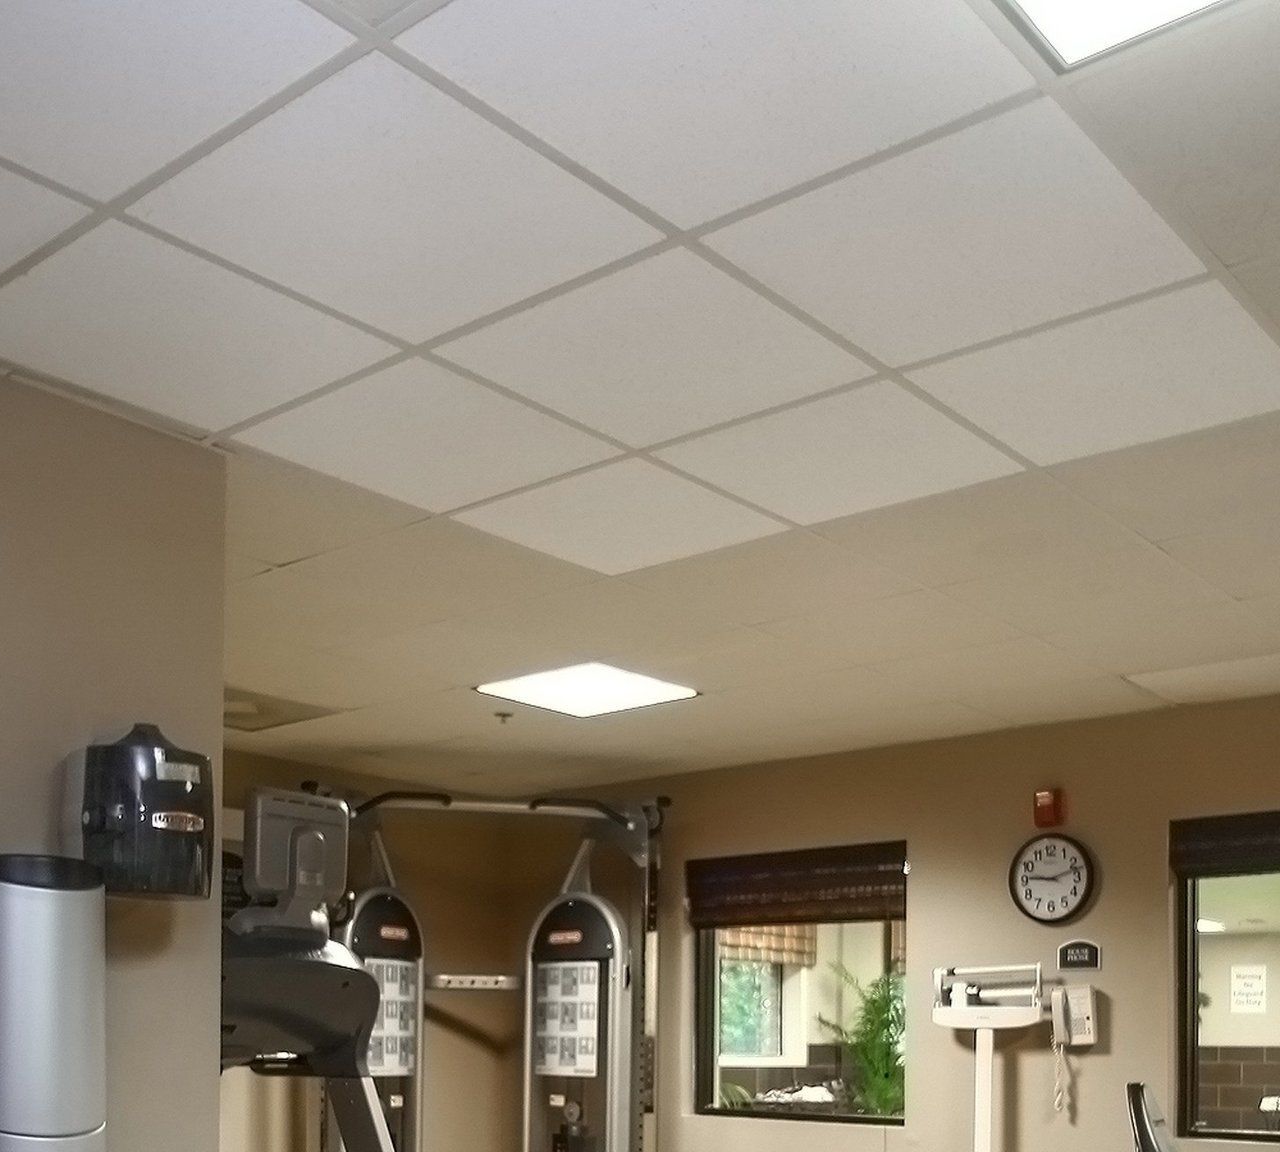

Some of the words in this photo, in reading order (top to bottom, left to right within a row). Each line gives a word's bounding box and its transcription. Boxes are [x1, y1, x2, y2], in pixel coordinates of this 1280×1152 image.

[1034, 849, 1042, 861] 11
[1044, 844, 1056, 857] 12
[1023, 860, 1034, 873] 10
[1069, 856, 1078, 870] 2
[1021, 875, 1029, 887] 9
[1073, 870, 1081, 883] 3
[1025, 888, 1032, 900] 8
[1070, 885, 1077, 897] 4
[1034, 898, 1041, 909] 7
[1047, 900, 1055, 913] 6
[1060, 896, 1068, 908] 5
